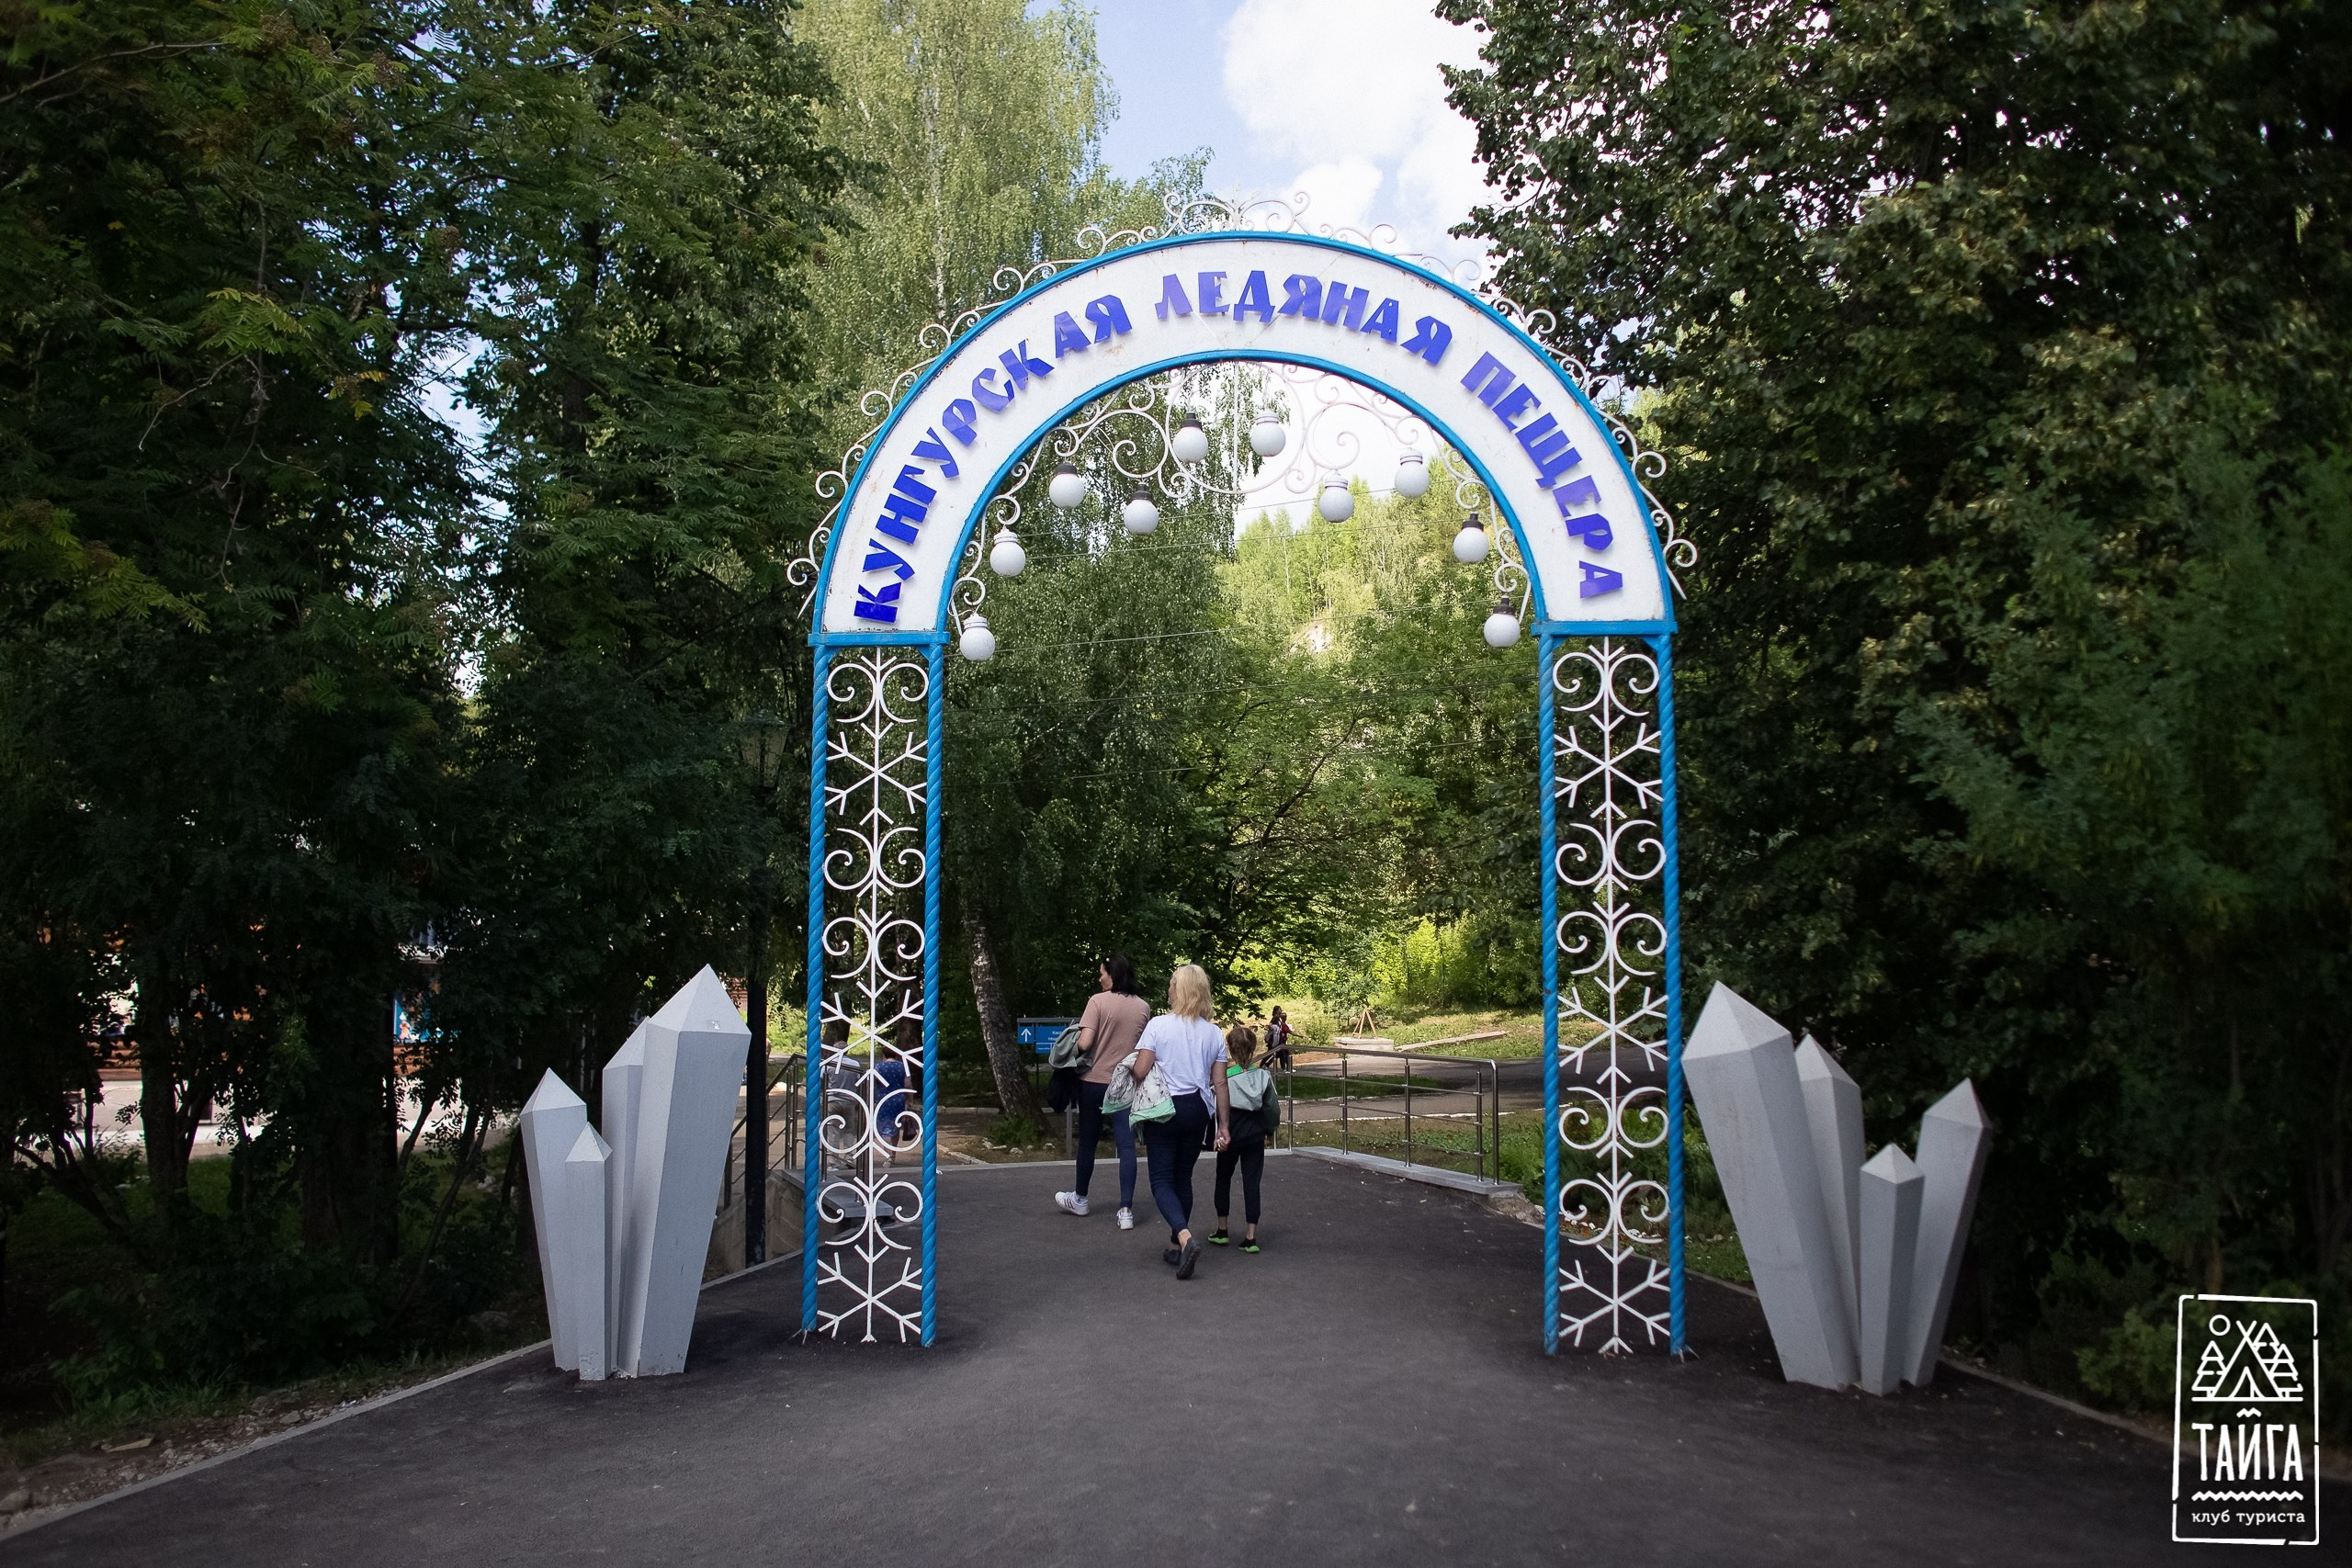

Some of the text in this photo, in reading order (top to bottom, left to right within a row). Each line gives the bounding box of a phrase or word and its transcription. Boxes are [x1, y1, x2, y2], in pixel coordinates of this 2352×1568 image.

[854, 270, 1623, 623] КУНГУРСКАЯ ЛЕДЯНАЯ ПЕЩЕРА
